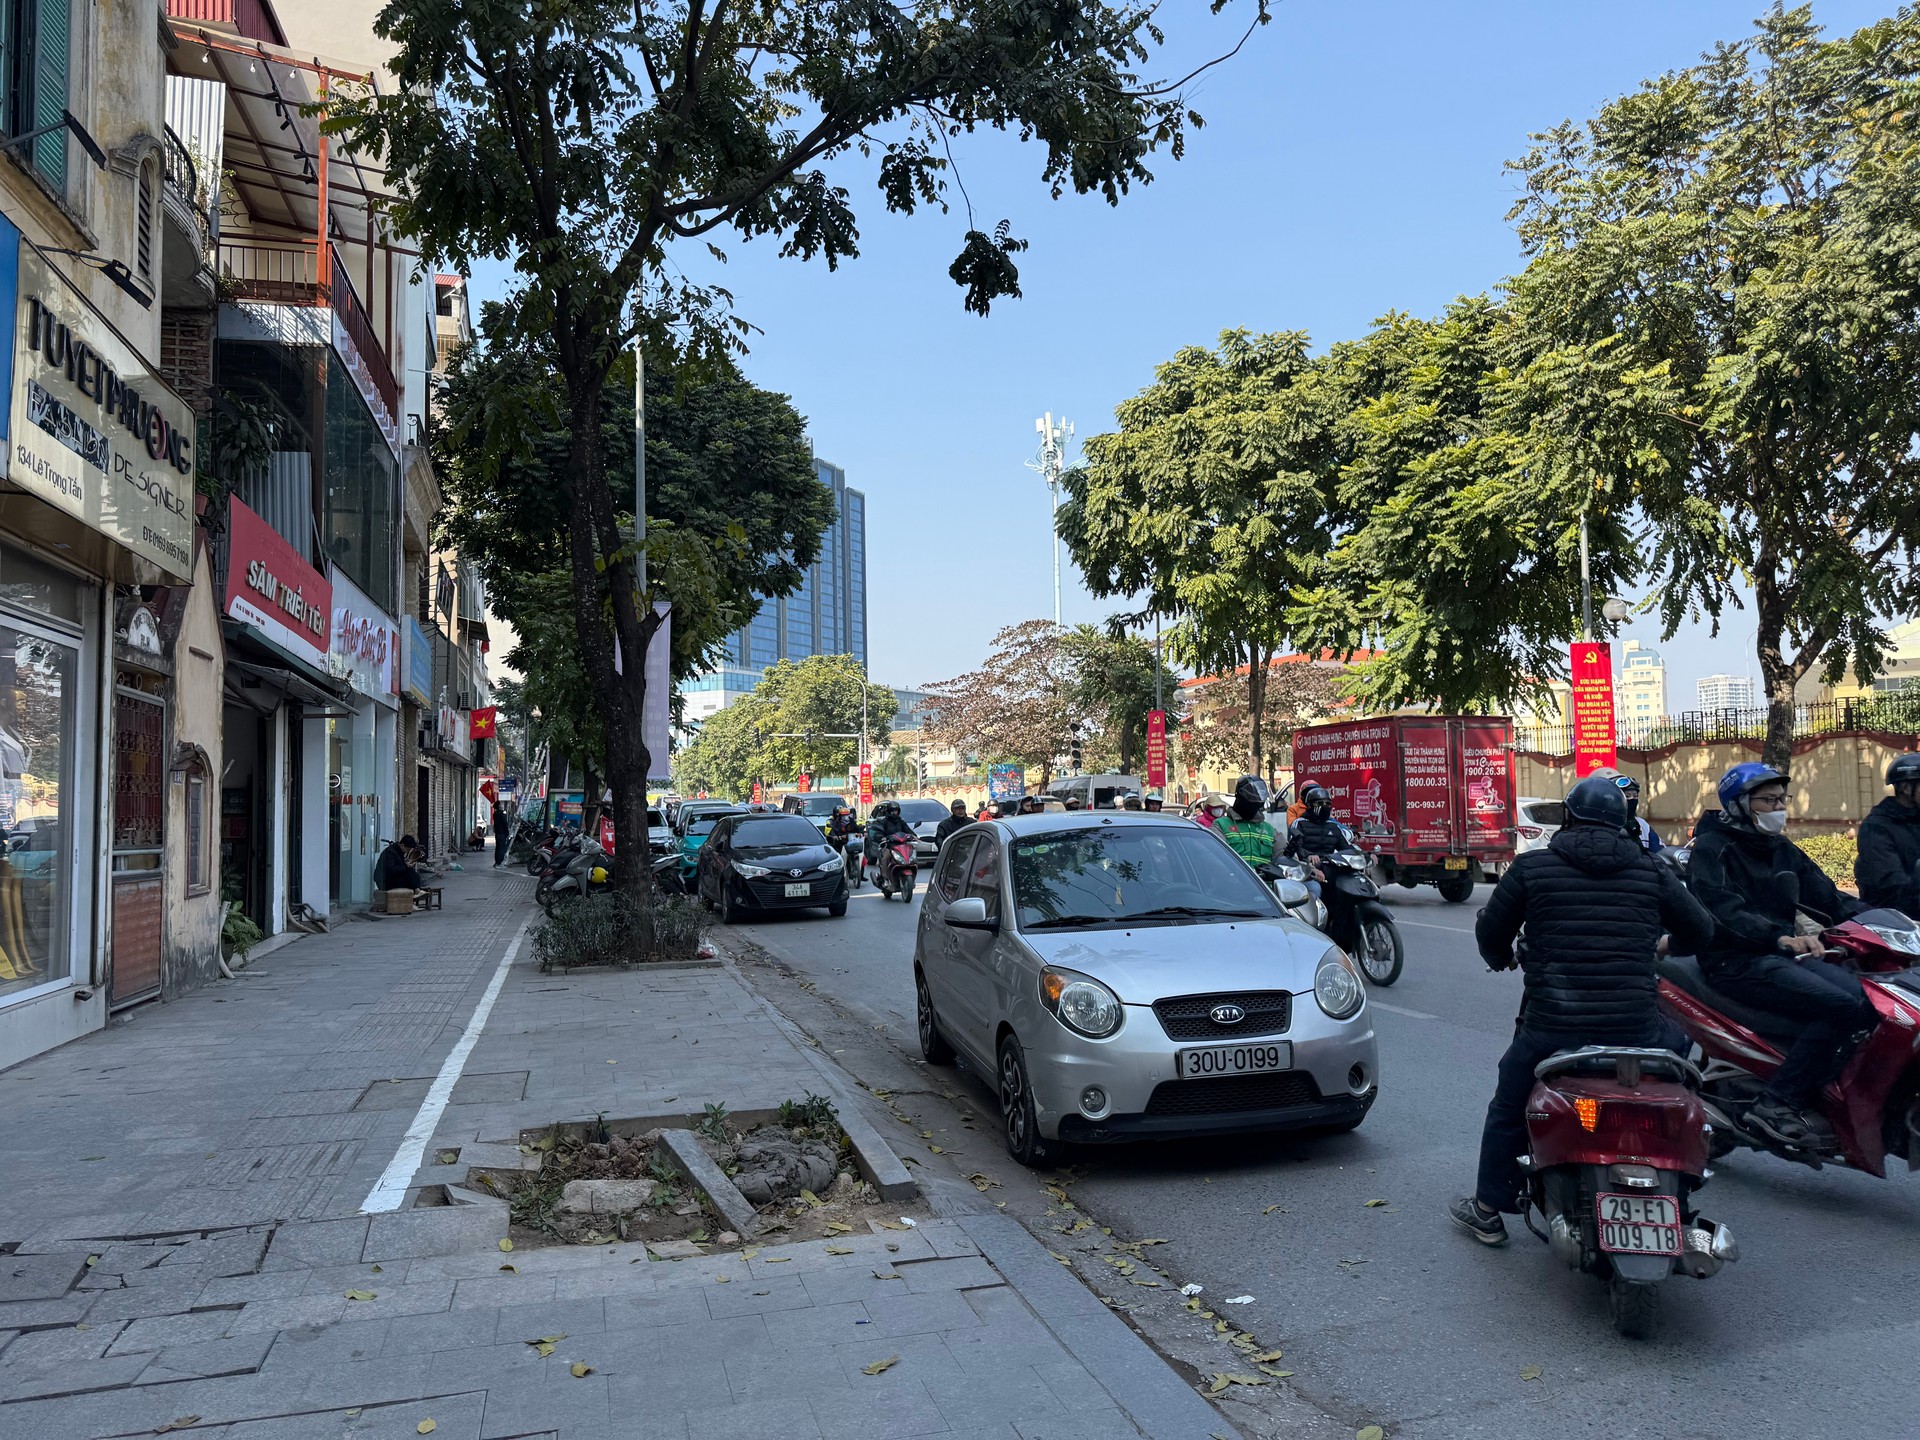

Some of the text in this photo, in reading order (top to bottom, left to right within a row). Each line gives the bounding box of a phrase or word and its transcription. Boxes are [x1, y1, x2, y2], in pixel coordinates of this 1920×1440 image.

[17, 444, 82, 500] 134 Lê Trọng Tấn
[114, 452, 187, 521] DESIGNER
[246, 559, 277, 601] SÂM
[1310, 749, 1320, 761] GỌI
[1321, 746, 1336, 760] MIỄN
[1350, 742, 1380, 759] 1800.00.33
[1333, 762, 1356, 772] 38.733.733
[1405, 777, 1447, 787] 1800.00.33
[1406, 801, 1446, 809] 29C-993.47
[1216, 1008, 1240, 1020] KIA
[1660, 990, 1706, 1018] FUTURE
[1189, 1046, 1279, 1074] 30U-0199
[1609, 1198, 1665, 1224] 29-E1
[1605, 1224, 1676, 1251] 009.18
